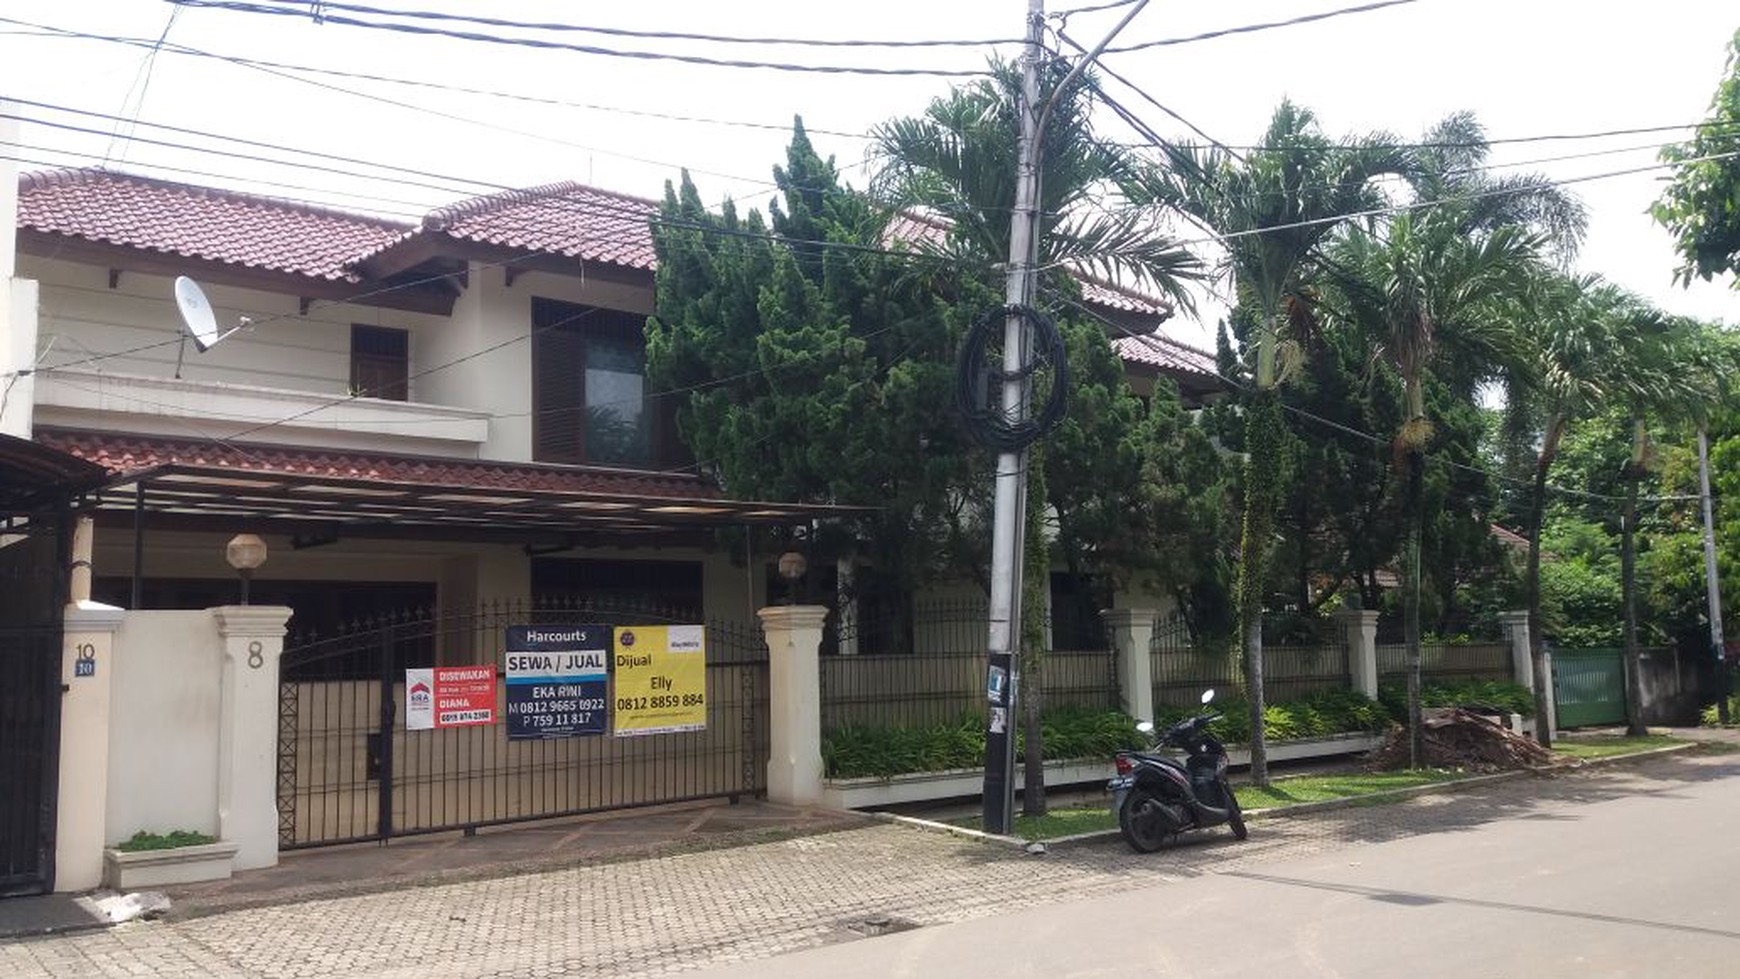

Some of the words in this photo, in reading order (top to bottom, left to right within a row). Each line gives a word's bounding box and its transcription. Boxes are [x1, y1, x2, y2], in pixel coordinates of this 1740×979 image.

[527, 630, 587, 642] Harcourts
[76, 643, 95, 660] 10
[247, 641, 264, 668] 8
[508, 656, 552, 671] SEWA
[566, 654, 603, 669] JUAL
[616, 652, 652, 669] Dijual
[439, 669, 490, 681] DISEWAKAN
[650, 675, 673, 691] Elly
[533, 687, 555, 698] EKA
[557, 685, 581, 697] RINI
[439, 698, 470, 708] DIANA
[508, 703, 518, 714] M
[520, 701, 547, 713] 0812
[550, 700, 576, 712] 9665
[617, 697, 647, 711] 0812
[650, 695, 679, 708] 8859
[682, 693, 704, 707] 884
[524, 716, 530, 727] P
[532, 715, 554, 727] 759
[556, 714, 568, 725] 11
[571, 712, 591, 724] 817
